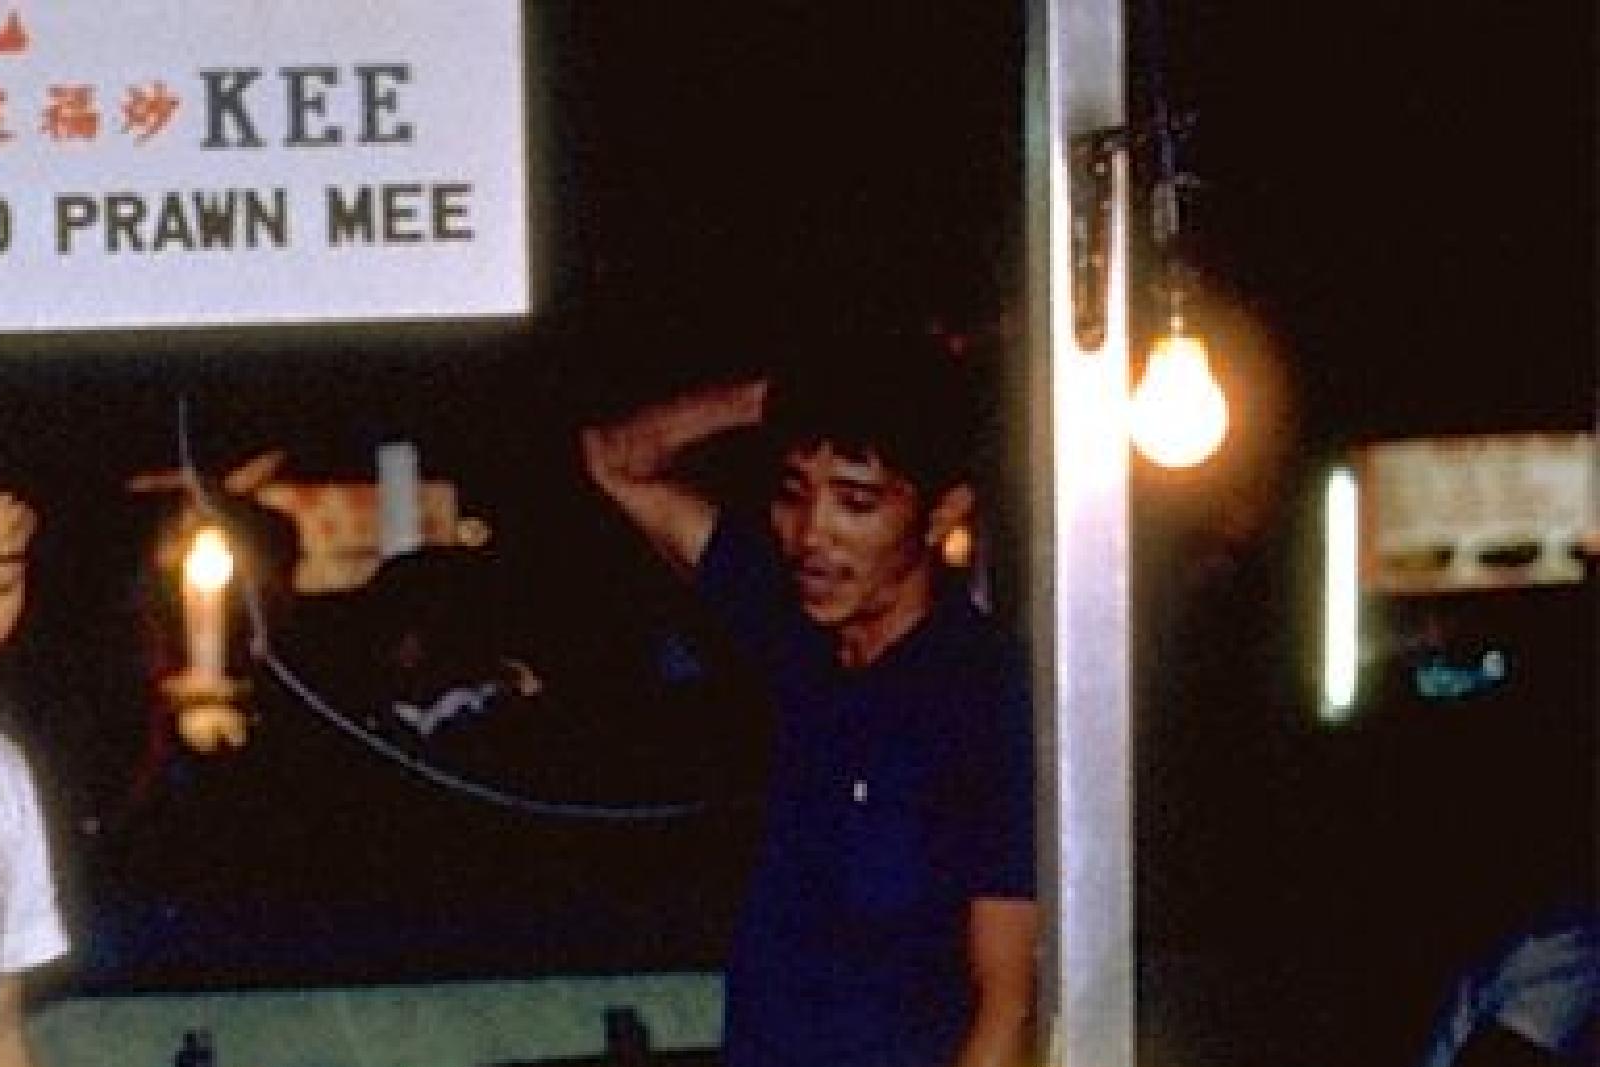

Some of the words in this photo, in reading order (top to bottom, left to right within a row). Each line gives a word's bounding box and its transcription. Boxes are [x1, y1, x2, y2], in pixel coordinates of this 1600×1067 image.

[197, 62, 414, 149] KEE
[55, 187, 289, 256] PRAWN
[326, 182, 475, 246] MEE
